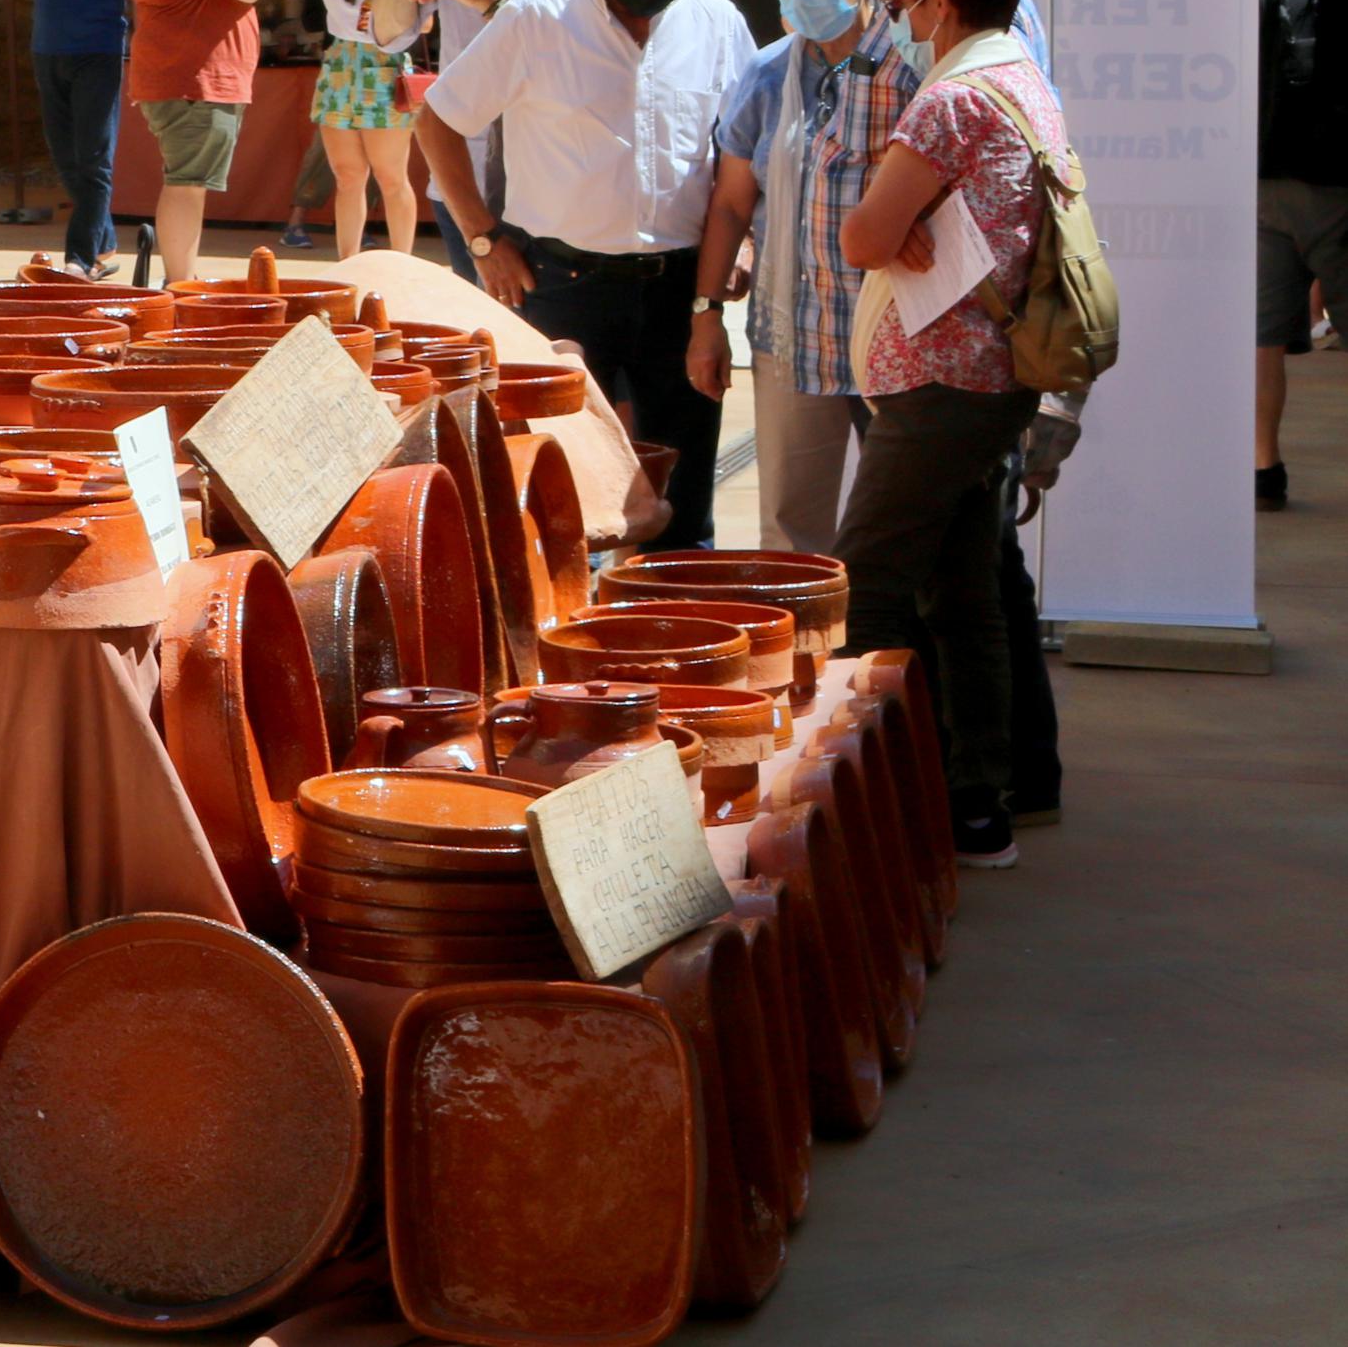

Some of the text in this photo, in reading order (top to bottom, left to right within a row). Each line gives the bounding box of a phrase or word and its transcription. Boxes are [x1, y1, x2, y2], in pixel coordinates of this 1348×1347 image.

[571, 758, 651, 835] PLATOS
[573, 809, 667, 876] PARA HACER
[593, 856, 677, 913] CHULETA
[638, 874, 716, 946] PLANCHA
